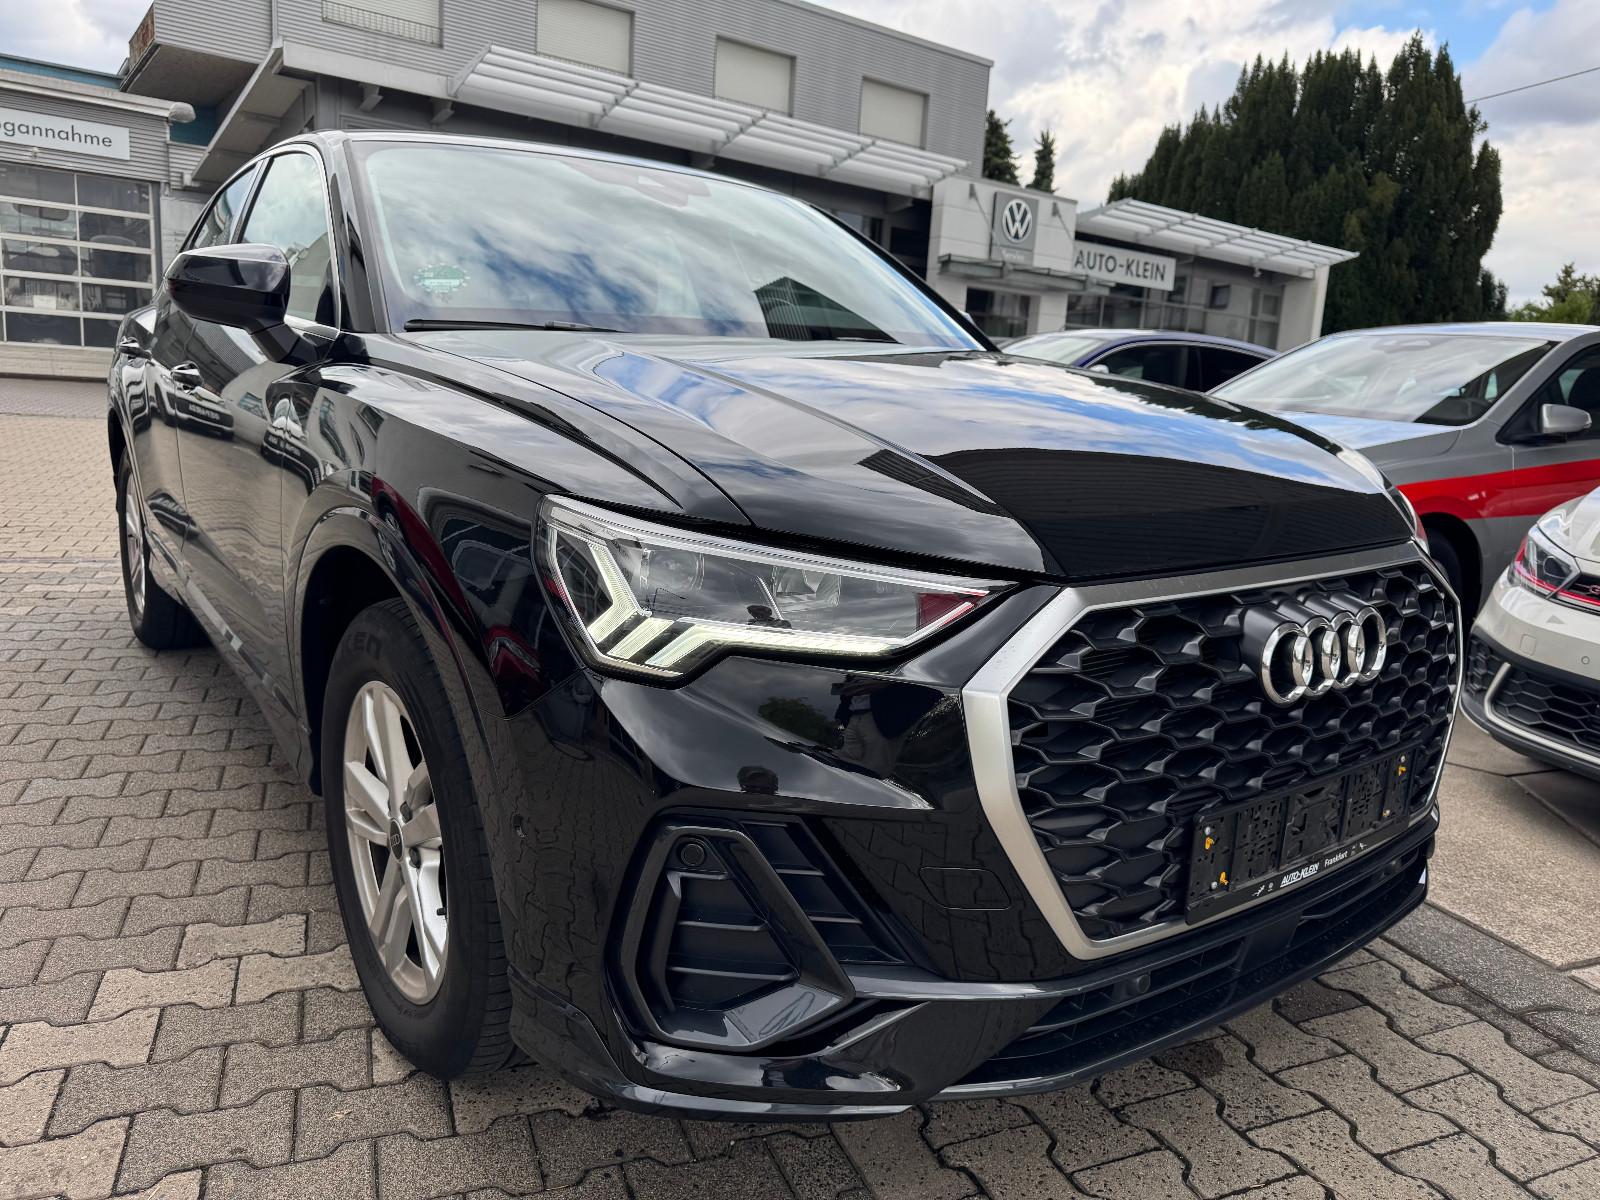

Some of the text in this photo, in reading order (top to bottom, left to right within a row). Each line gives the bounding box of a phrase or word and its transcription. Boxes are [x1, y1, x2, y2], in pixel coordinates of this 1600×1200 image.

[0, 121, 112, 147] gannahme
[1075, 250, 1166, 282] AUTO-KLEIN
[1281, 850, 1349, 886] AUTO-KLEIN Frankfurt
